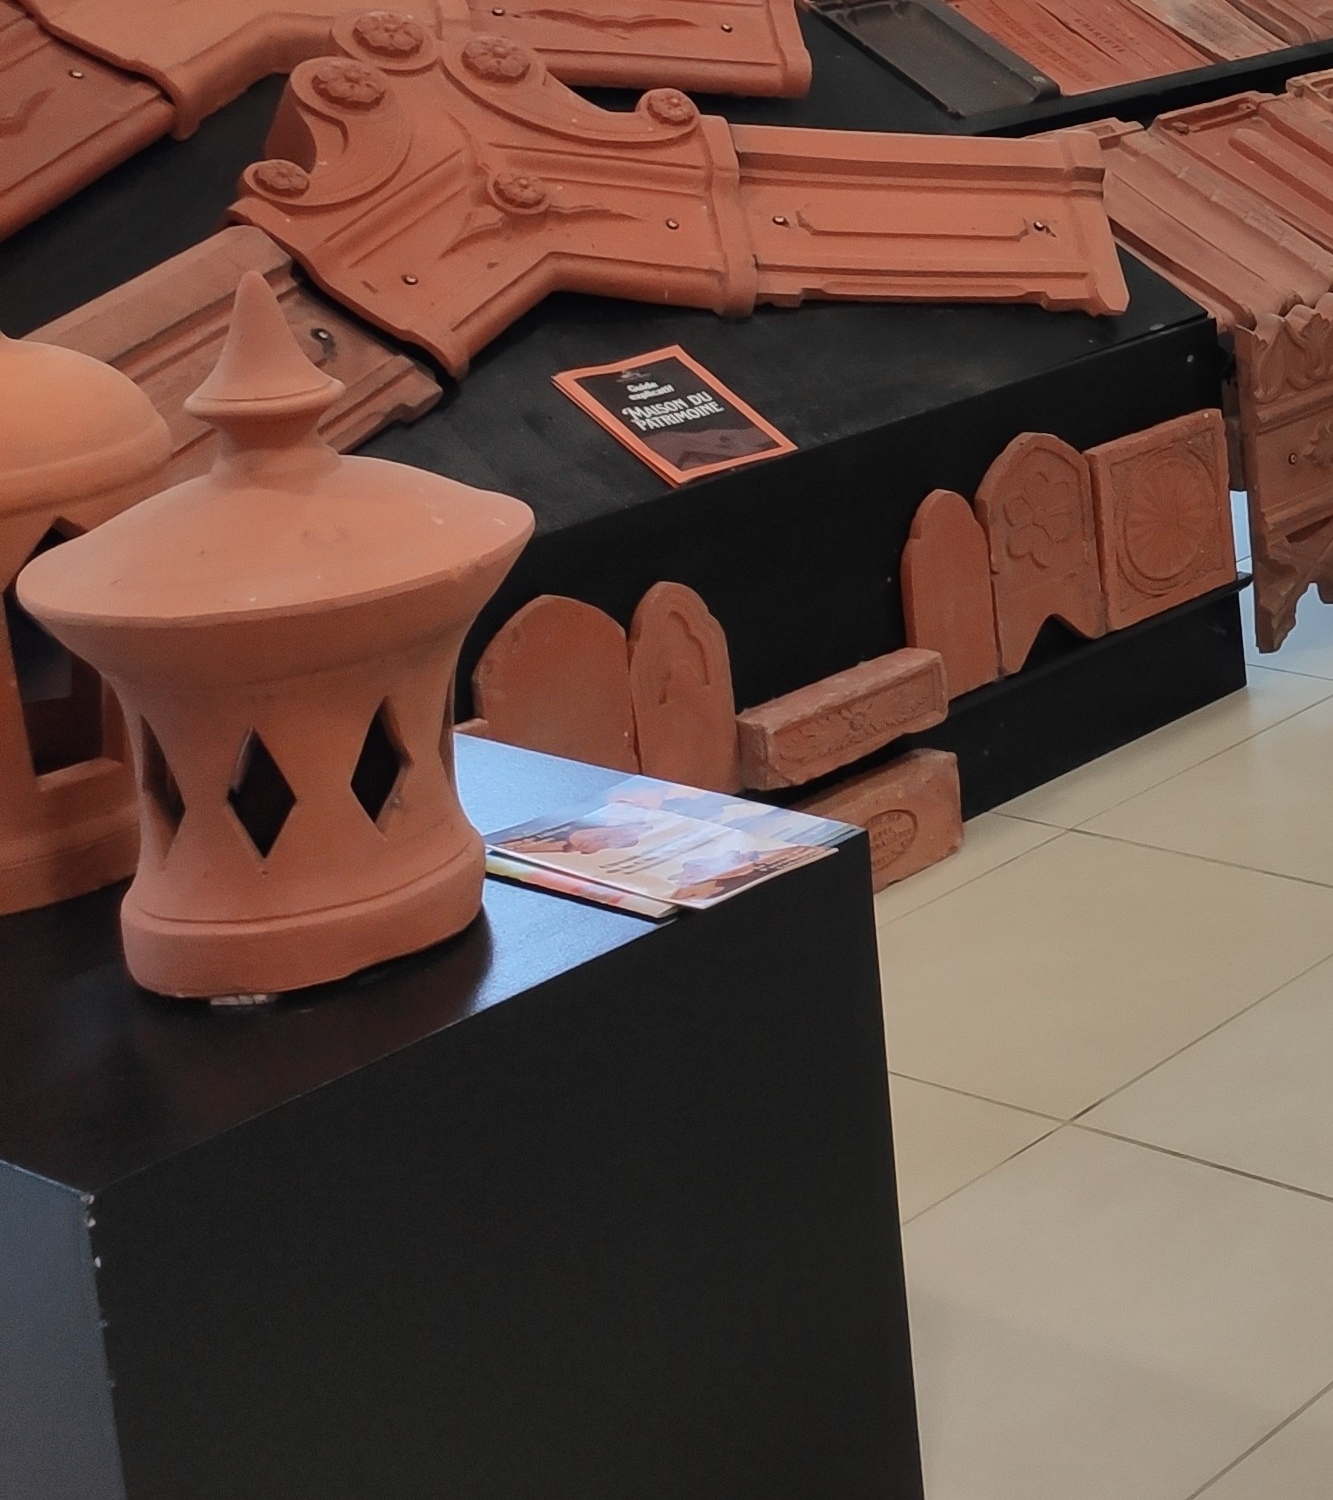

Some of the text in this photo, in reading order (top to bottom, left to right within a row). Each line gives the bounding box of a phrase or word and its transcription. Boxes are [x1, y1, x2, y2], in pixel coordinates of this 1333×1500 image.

[627, 381, 659, 392] Guide
[688, 391, 713, 406] DU
[631, 401, 726, 432] PATRIMOINE
